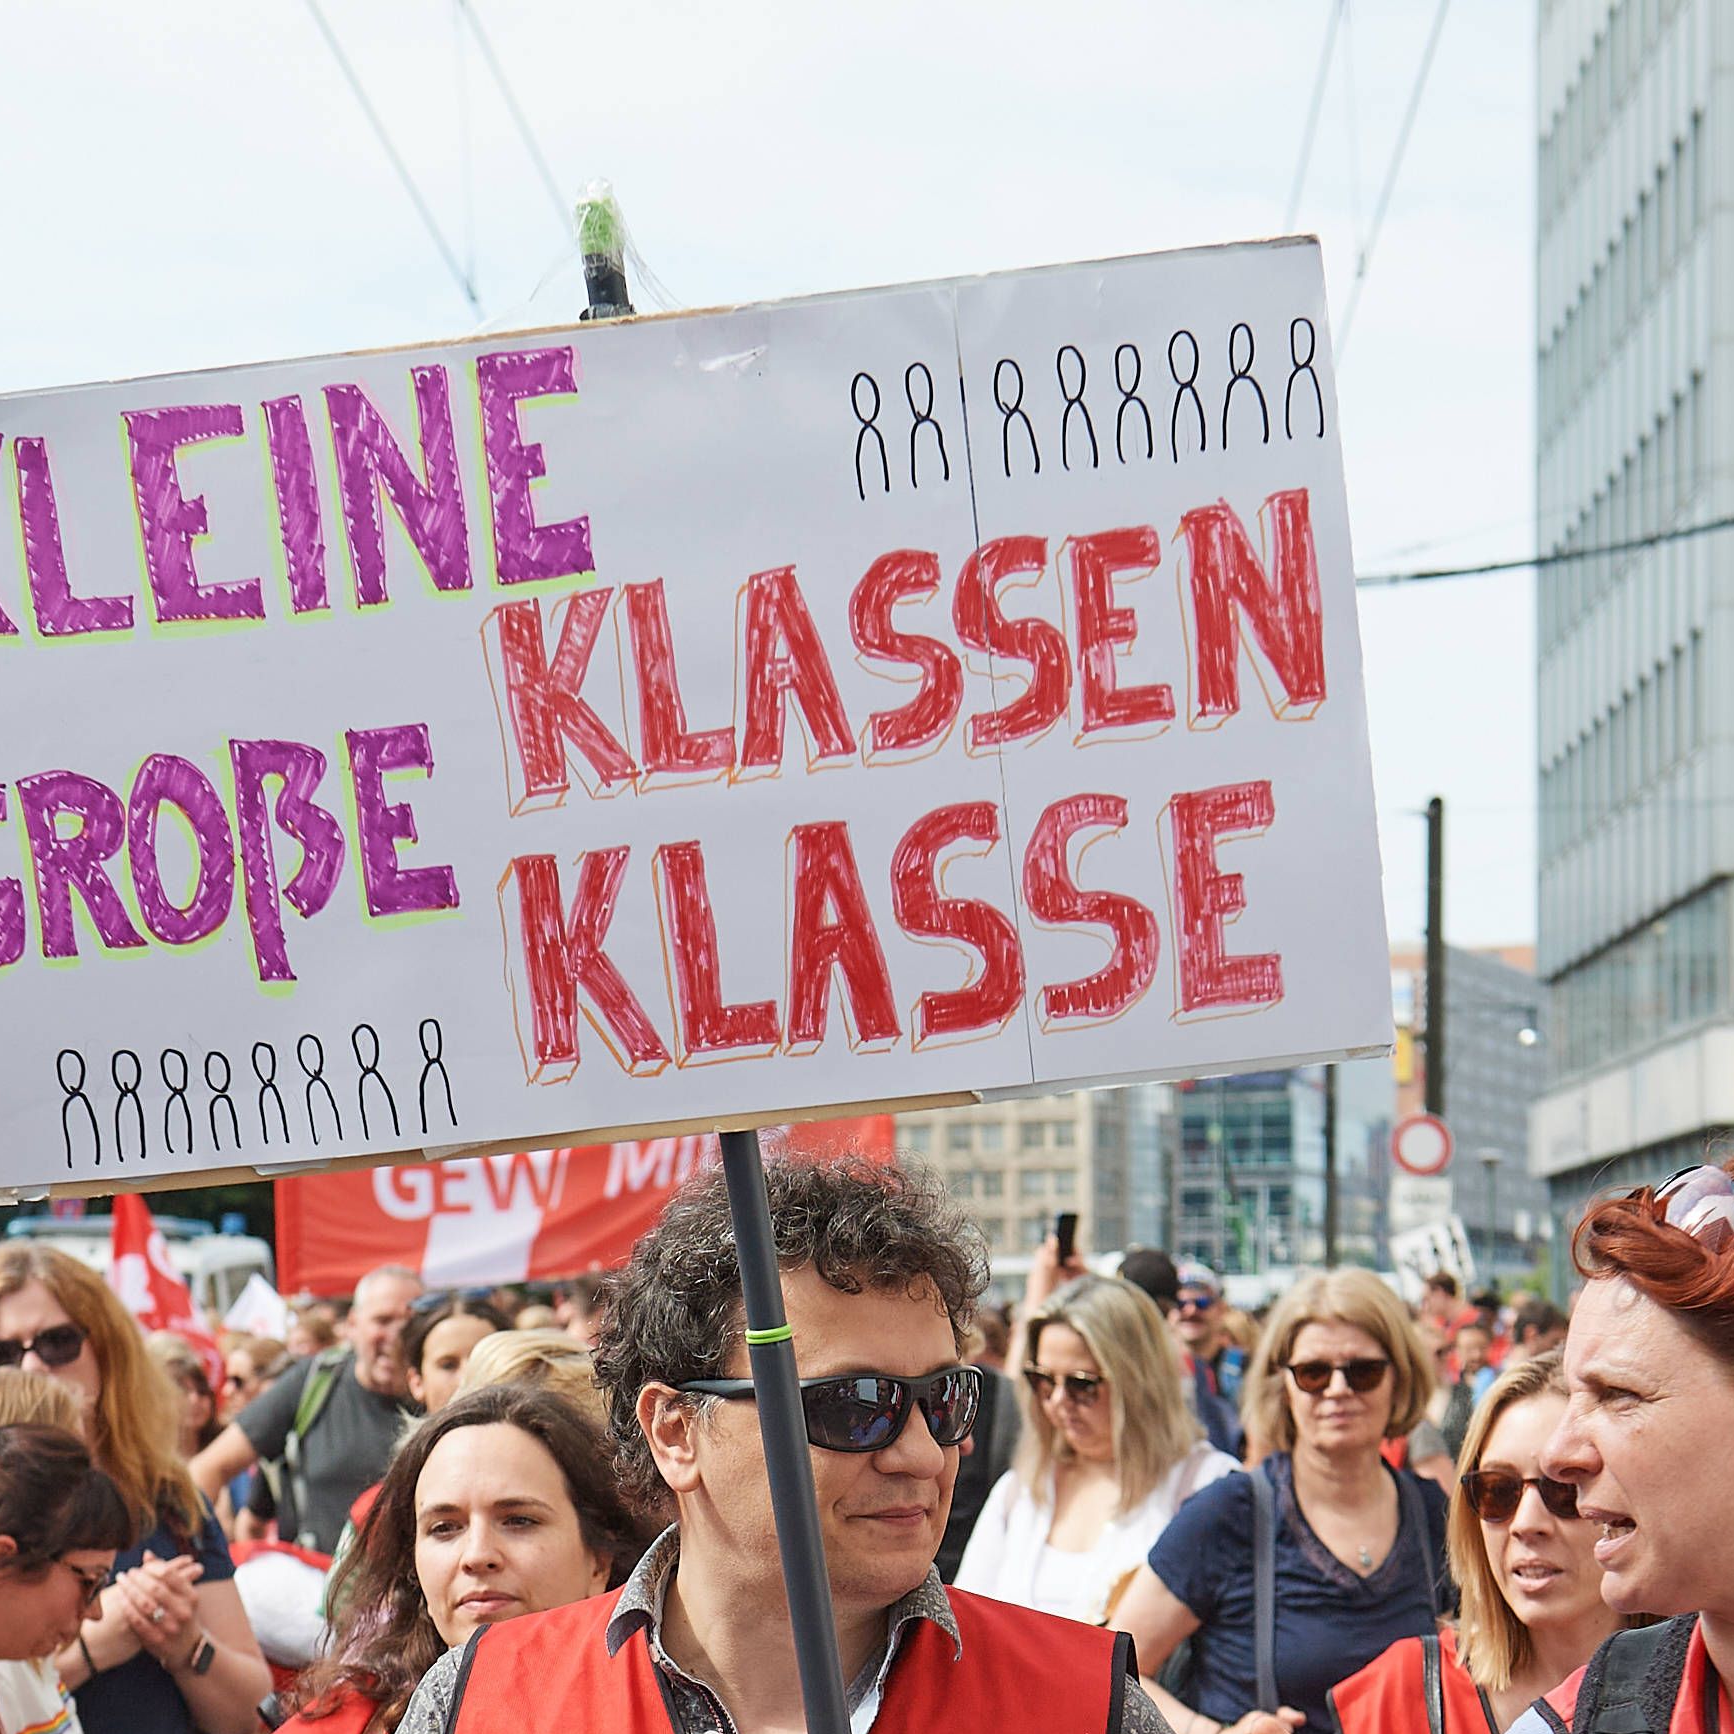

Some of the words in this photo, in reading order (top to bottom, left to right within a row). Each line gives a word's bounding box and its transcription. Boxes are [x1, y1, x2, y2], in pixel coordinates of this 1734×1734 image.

[481, 487, 1329, 818] KLASSEN
[498, 779, 1286, 1084] KLASSE
[371, 1148, 572, 1222] GEW
